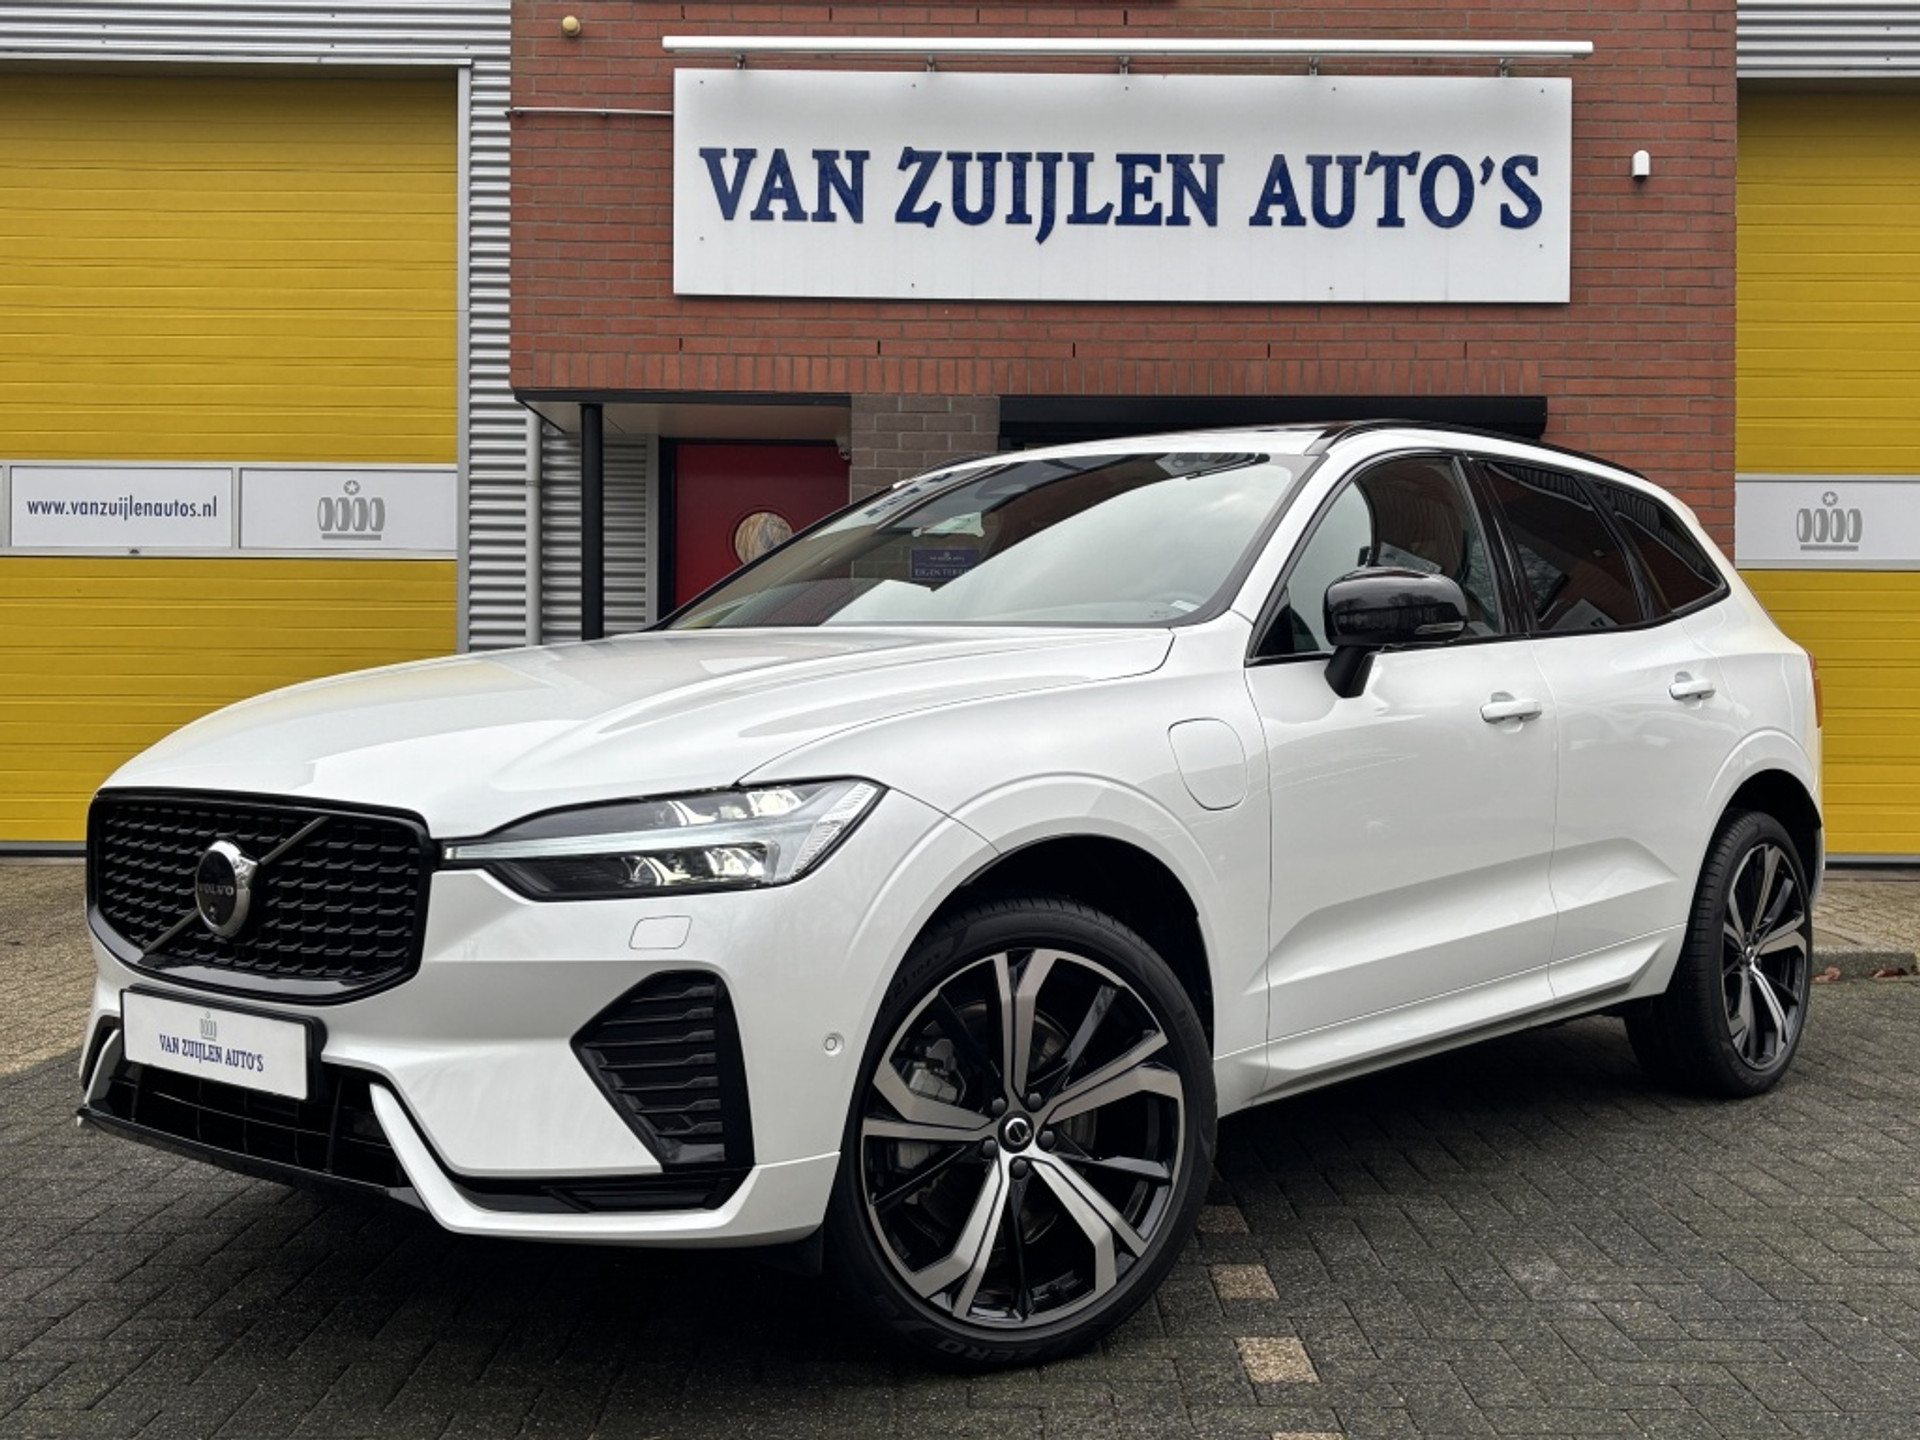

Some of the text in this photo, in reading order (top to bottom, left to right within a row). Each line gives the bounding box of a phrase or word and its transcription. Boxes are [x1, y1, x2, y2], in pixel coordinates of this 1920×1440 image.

[699, 146, 1542, 245] VAN ZUIJLEN AUTO'S
[27, 495, 217, 521] www.vanzuijlenautos.nl
[198, 882, 235, 896] VOLVO
[159, 1033, 264, 1072] VAN ZUIJLEN AUTO'S
